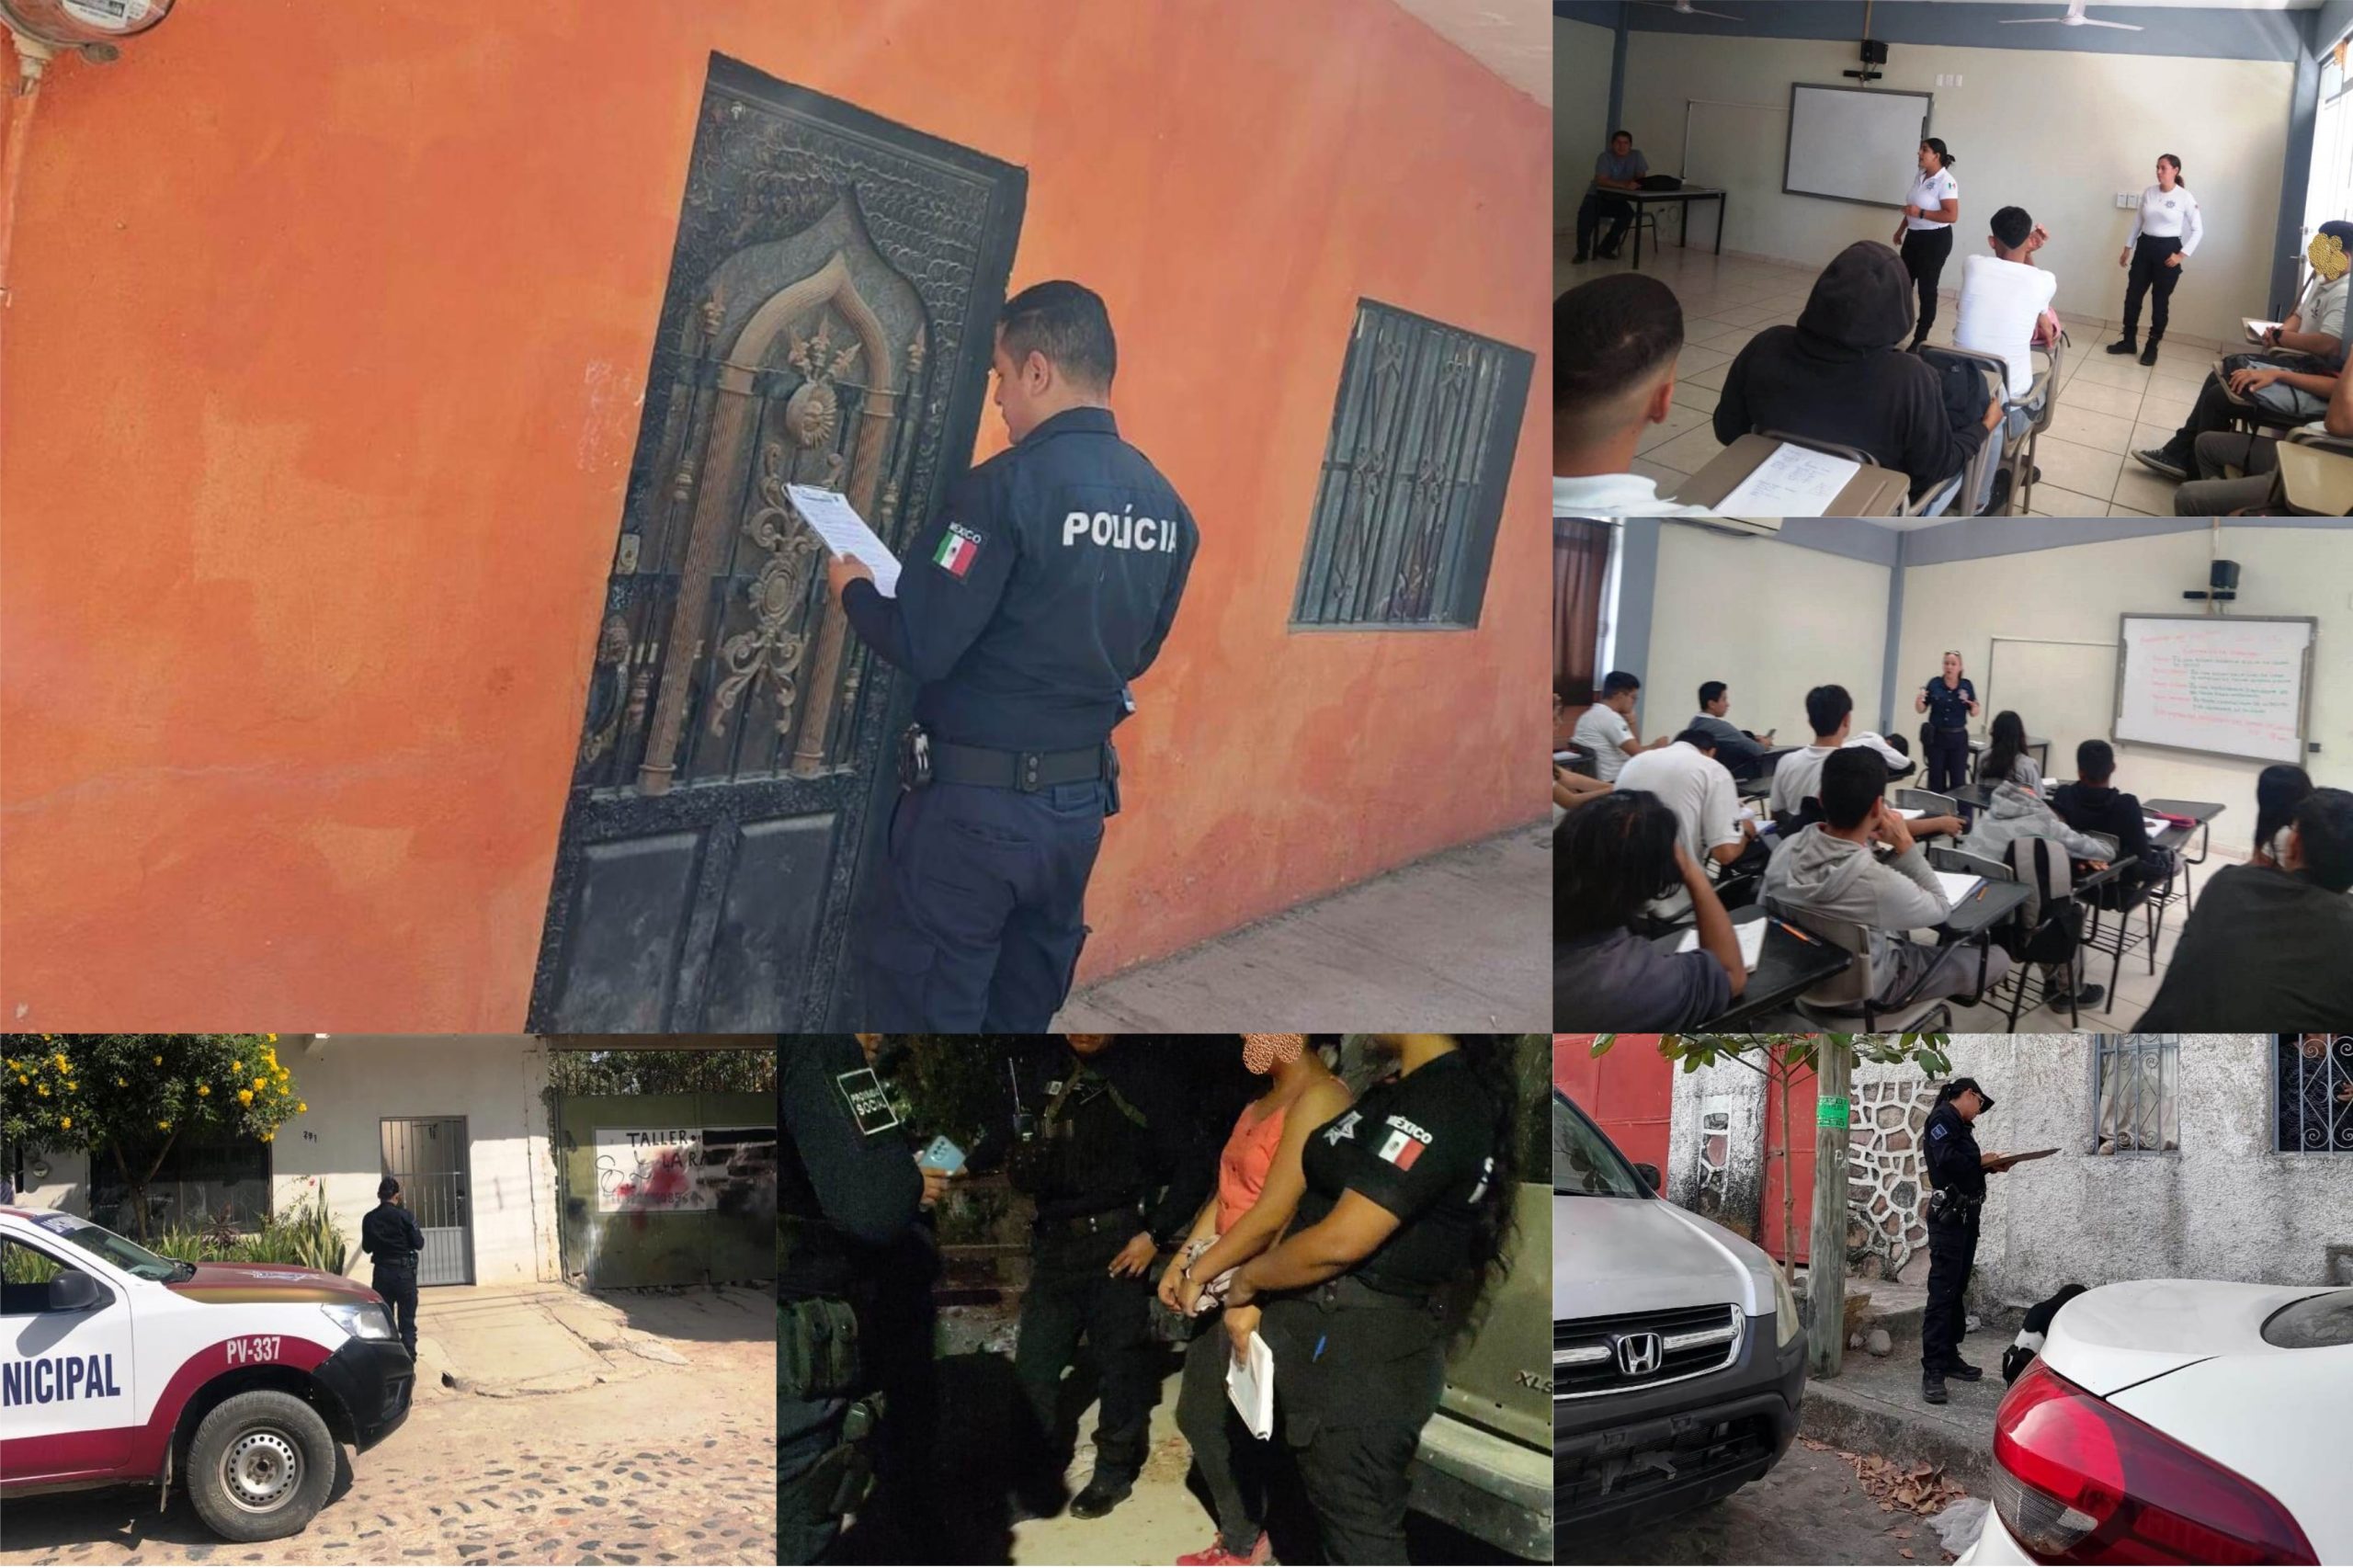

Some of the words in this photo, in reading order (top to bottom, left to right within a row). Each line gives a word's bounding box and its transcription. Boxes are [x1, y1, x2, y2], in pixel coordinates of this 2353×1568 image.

[856, 1099, 887, 1116] SOC
[626, 1130, 688, 1147] TALLER
[227, 1336, 280, 1364] PV-337
[3, 1353, 120, 1406] NICIPAL
